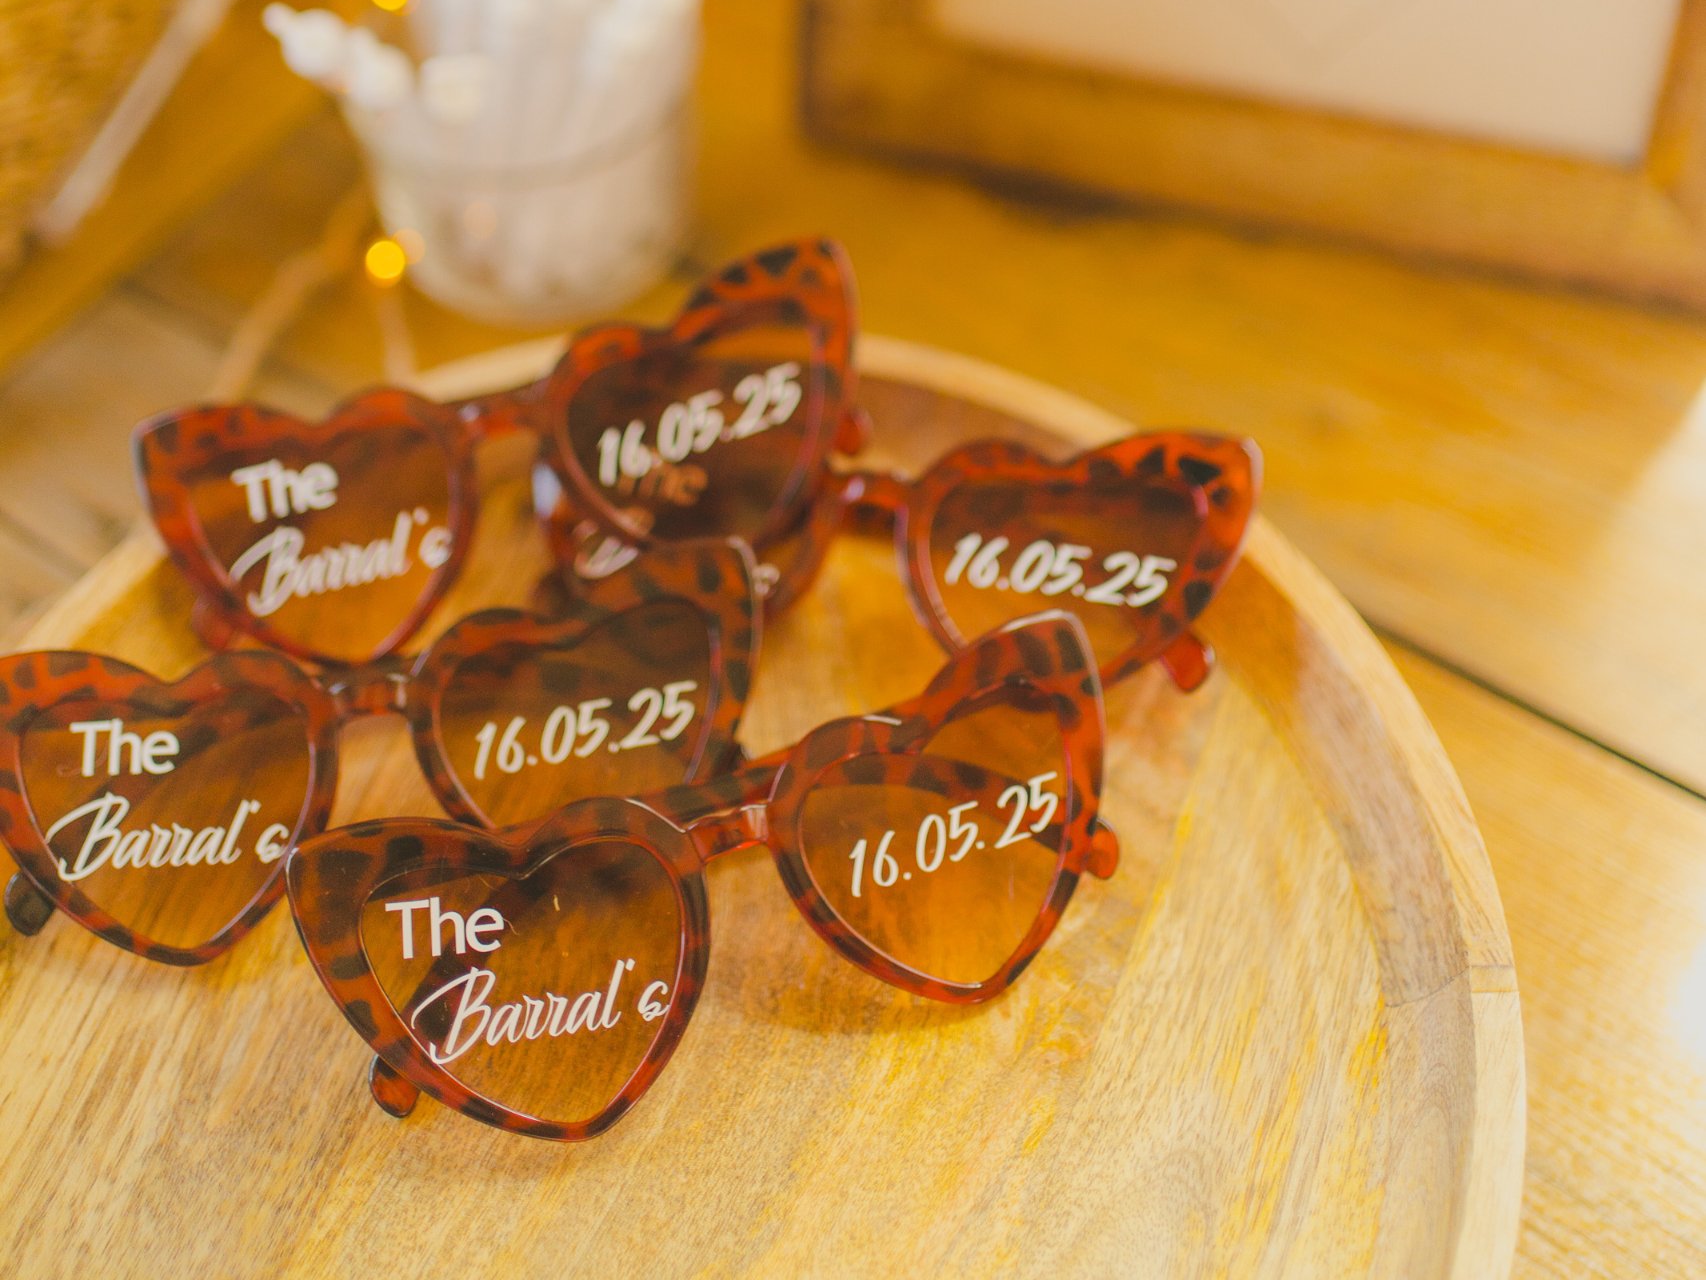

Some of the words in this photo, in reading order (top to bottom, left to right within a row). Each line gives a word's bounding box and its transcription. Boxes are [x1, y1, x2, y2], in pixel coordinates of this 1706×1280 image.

[597, 362, 802, 486] 16.05.25
[231, 458, 339, 523] The
[944, 532, 1177, 608] 16.05.25
[70, 718, 180, 777] The
[473, 680, 698, 780] 16.05.25
[848, 771, 1061, 898] 16.05.25
[385, 896, 505, 960] The
